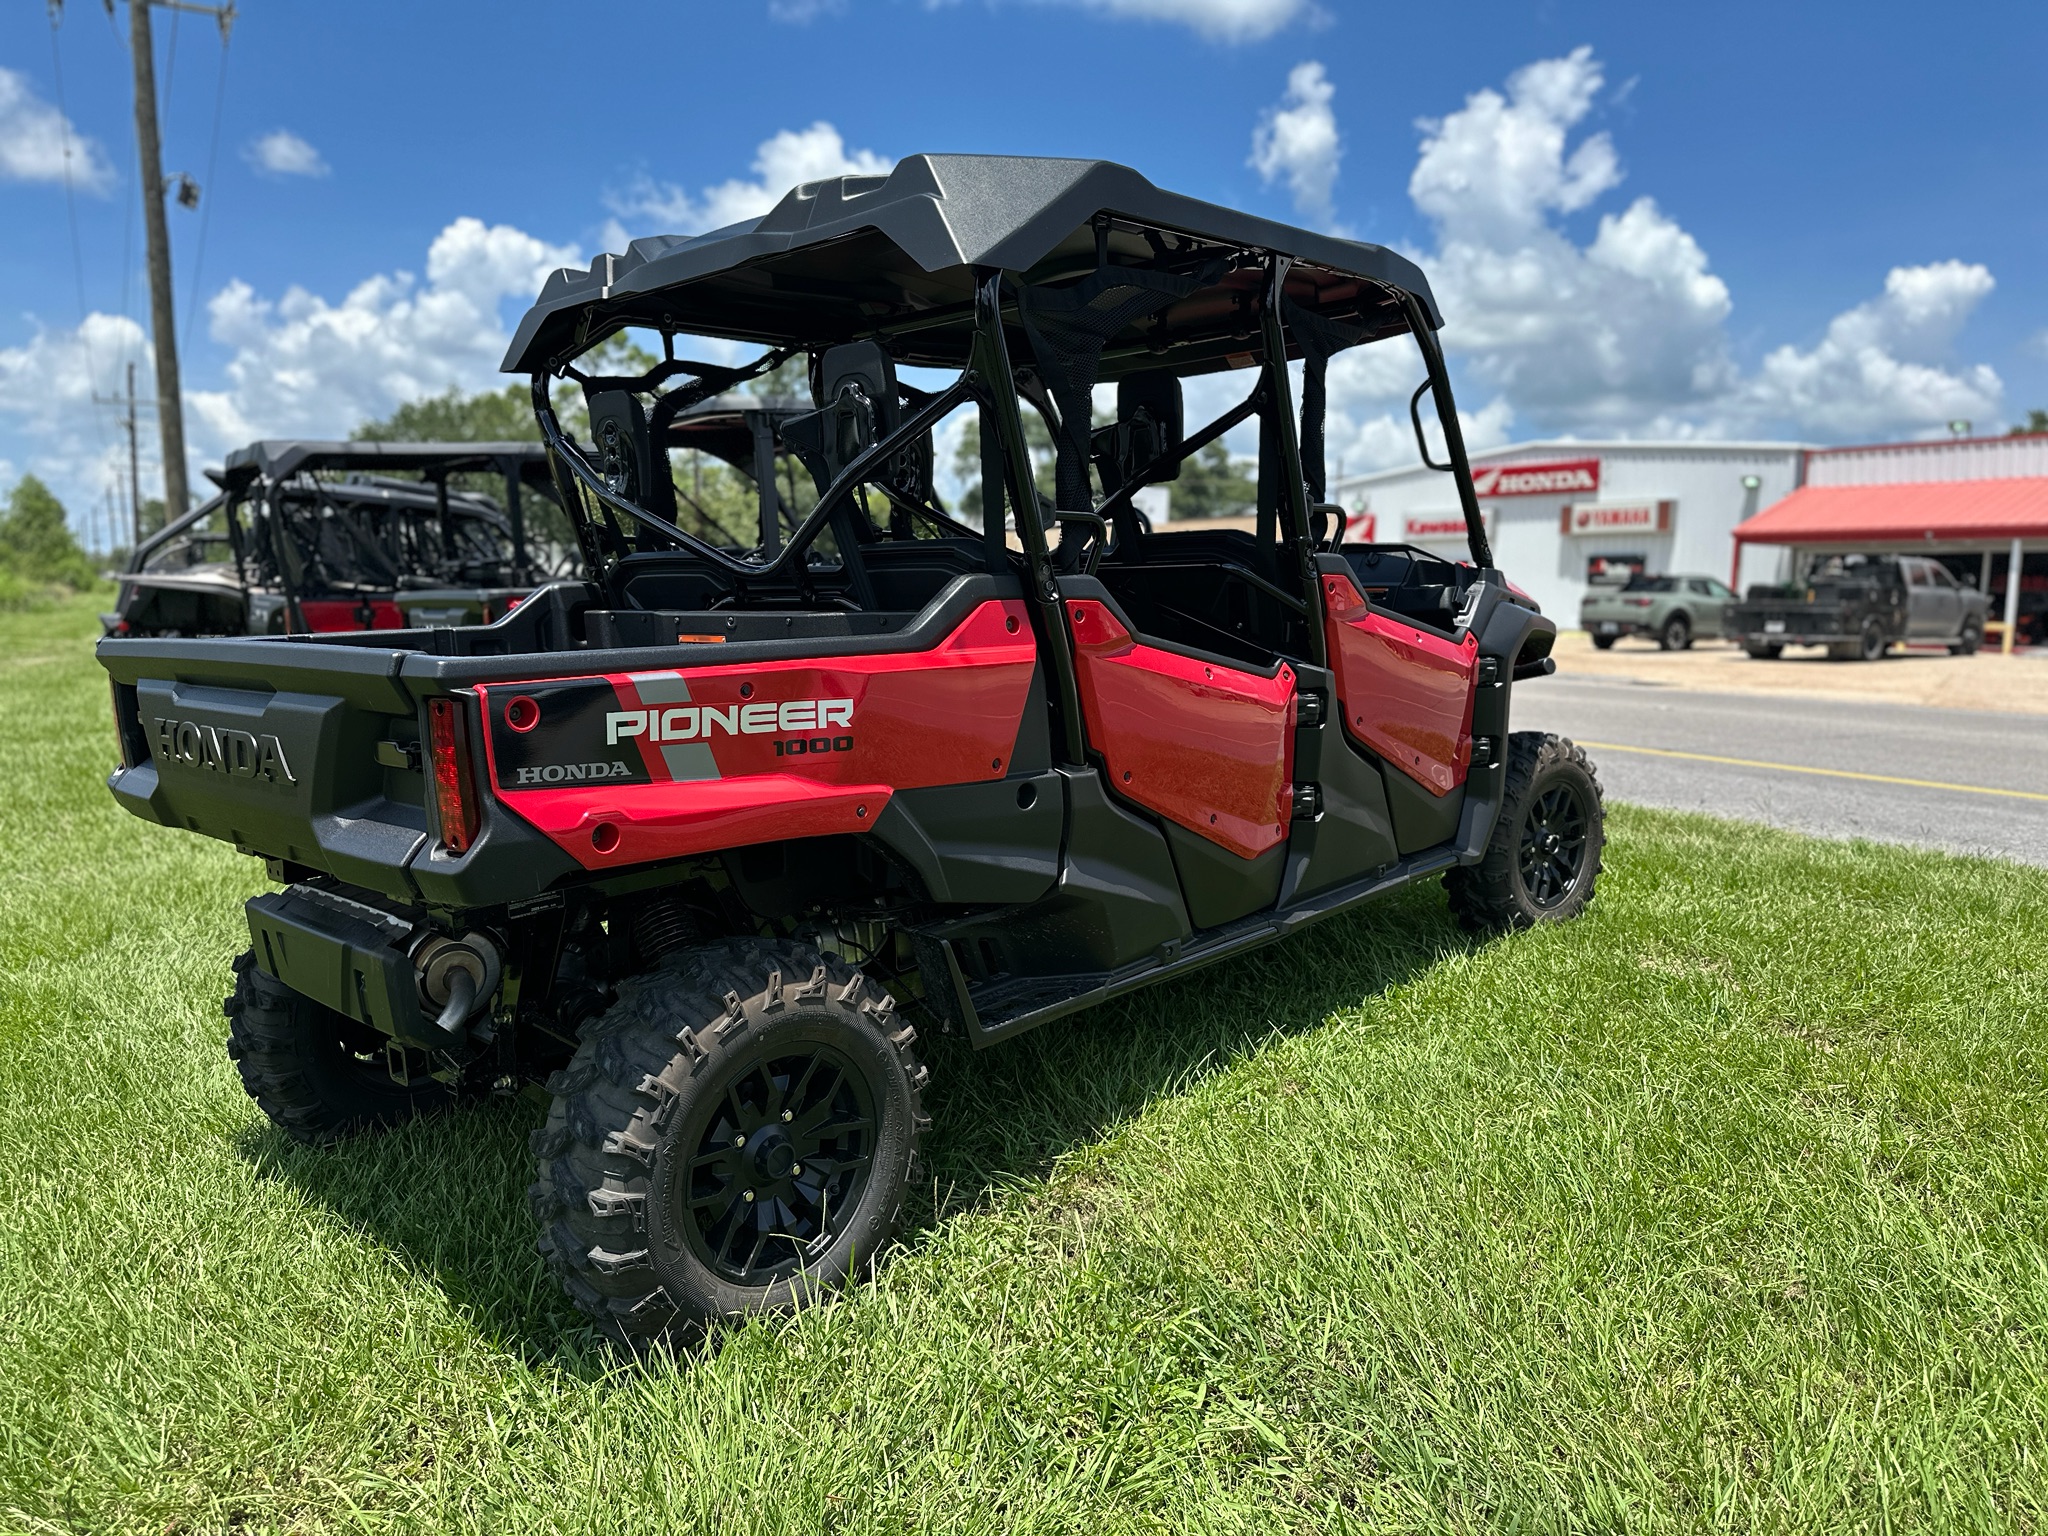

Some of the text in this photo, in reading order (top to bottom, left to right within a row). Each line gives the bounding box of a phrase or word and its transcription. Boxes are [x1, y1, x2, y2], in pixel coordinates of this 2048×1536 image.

[1497, 469, 1595, 493] HONDA
[1594, 507, 1651, 526] YAMAHA
[606, 699, 854, 745] PIONEER
[154, 718, 297, 786] HONDA
[773, 736, 855, 756] 1000
[516, 761, 632, 784] HONDA
